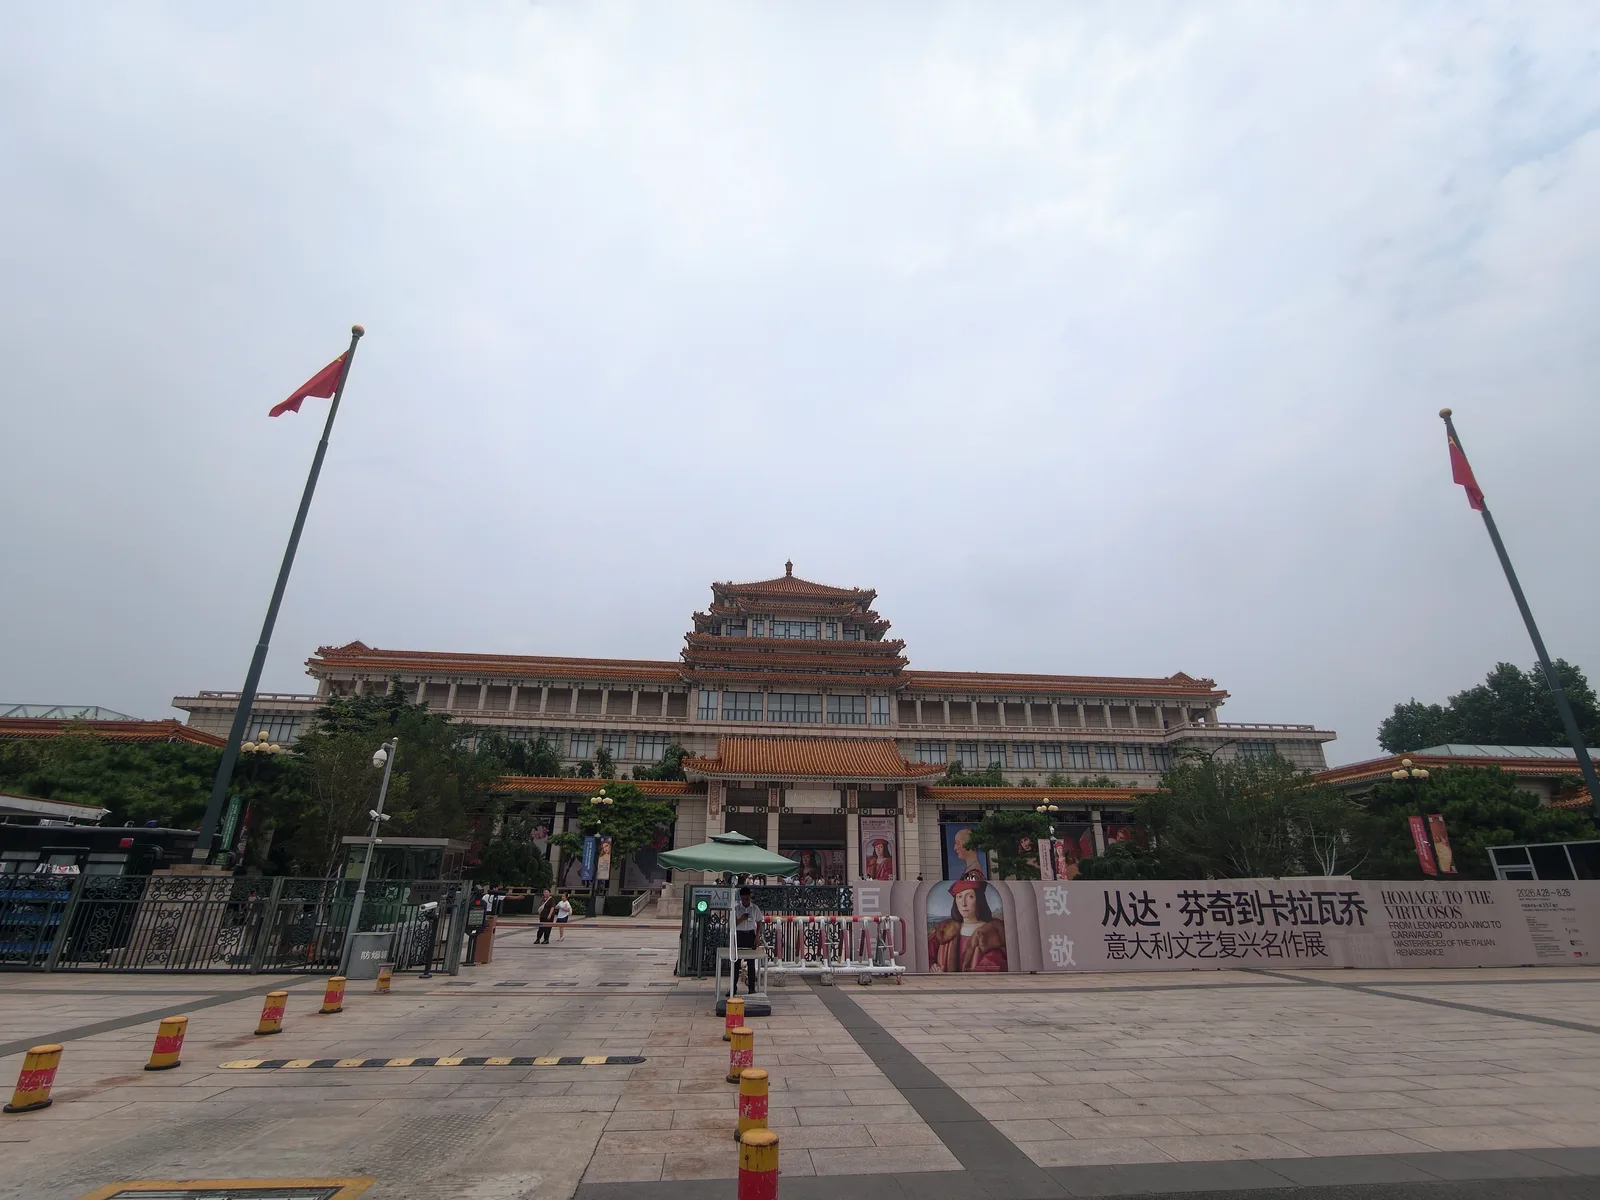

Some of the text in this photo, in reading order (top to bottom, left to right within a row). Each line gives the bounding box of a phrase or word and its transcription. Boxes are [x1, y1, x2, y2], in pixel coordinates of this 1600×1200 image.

[1380, 890, 1494, 905] HOMAGE TO THE
[1101, 889, 1369, 927] 从达·芬奇到卡拉瓦乔
[1384, 905, 1463, 920] VIRTUOSOS
[1043, 885, 1077, 967] 致敬
[1388, 921, 1502, 930] FROM LEONARDO DA VINCI TO
[1391, 930, 1443, 939] CARAVAGGIO
[1103, 930, 1329, 960] 意大利文艺复兴名作展
[1394, 940, 1446, 948] MASTERPIECES
[1471, 939, 1496, 947] ITALIAN
[1396, 948, 1445, 957] RENAISSANCE
